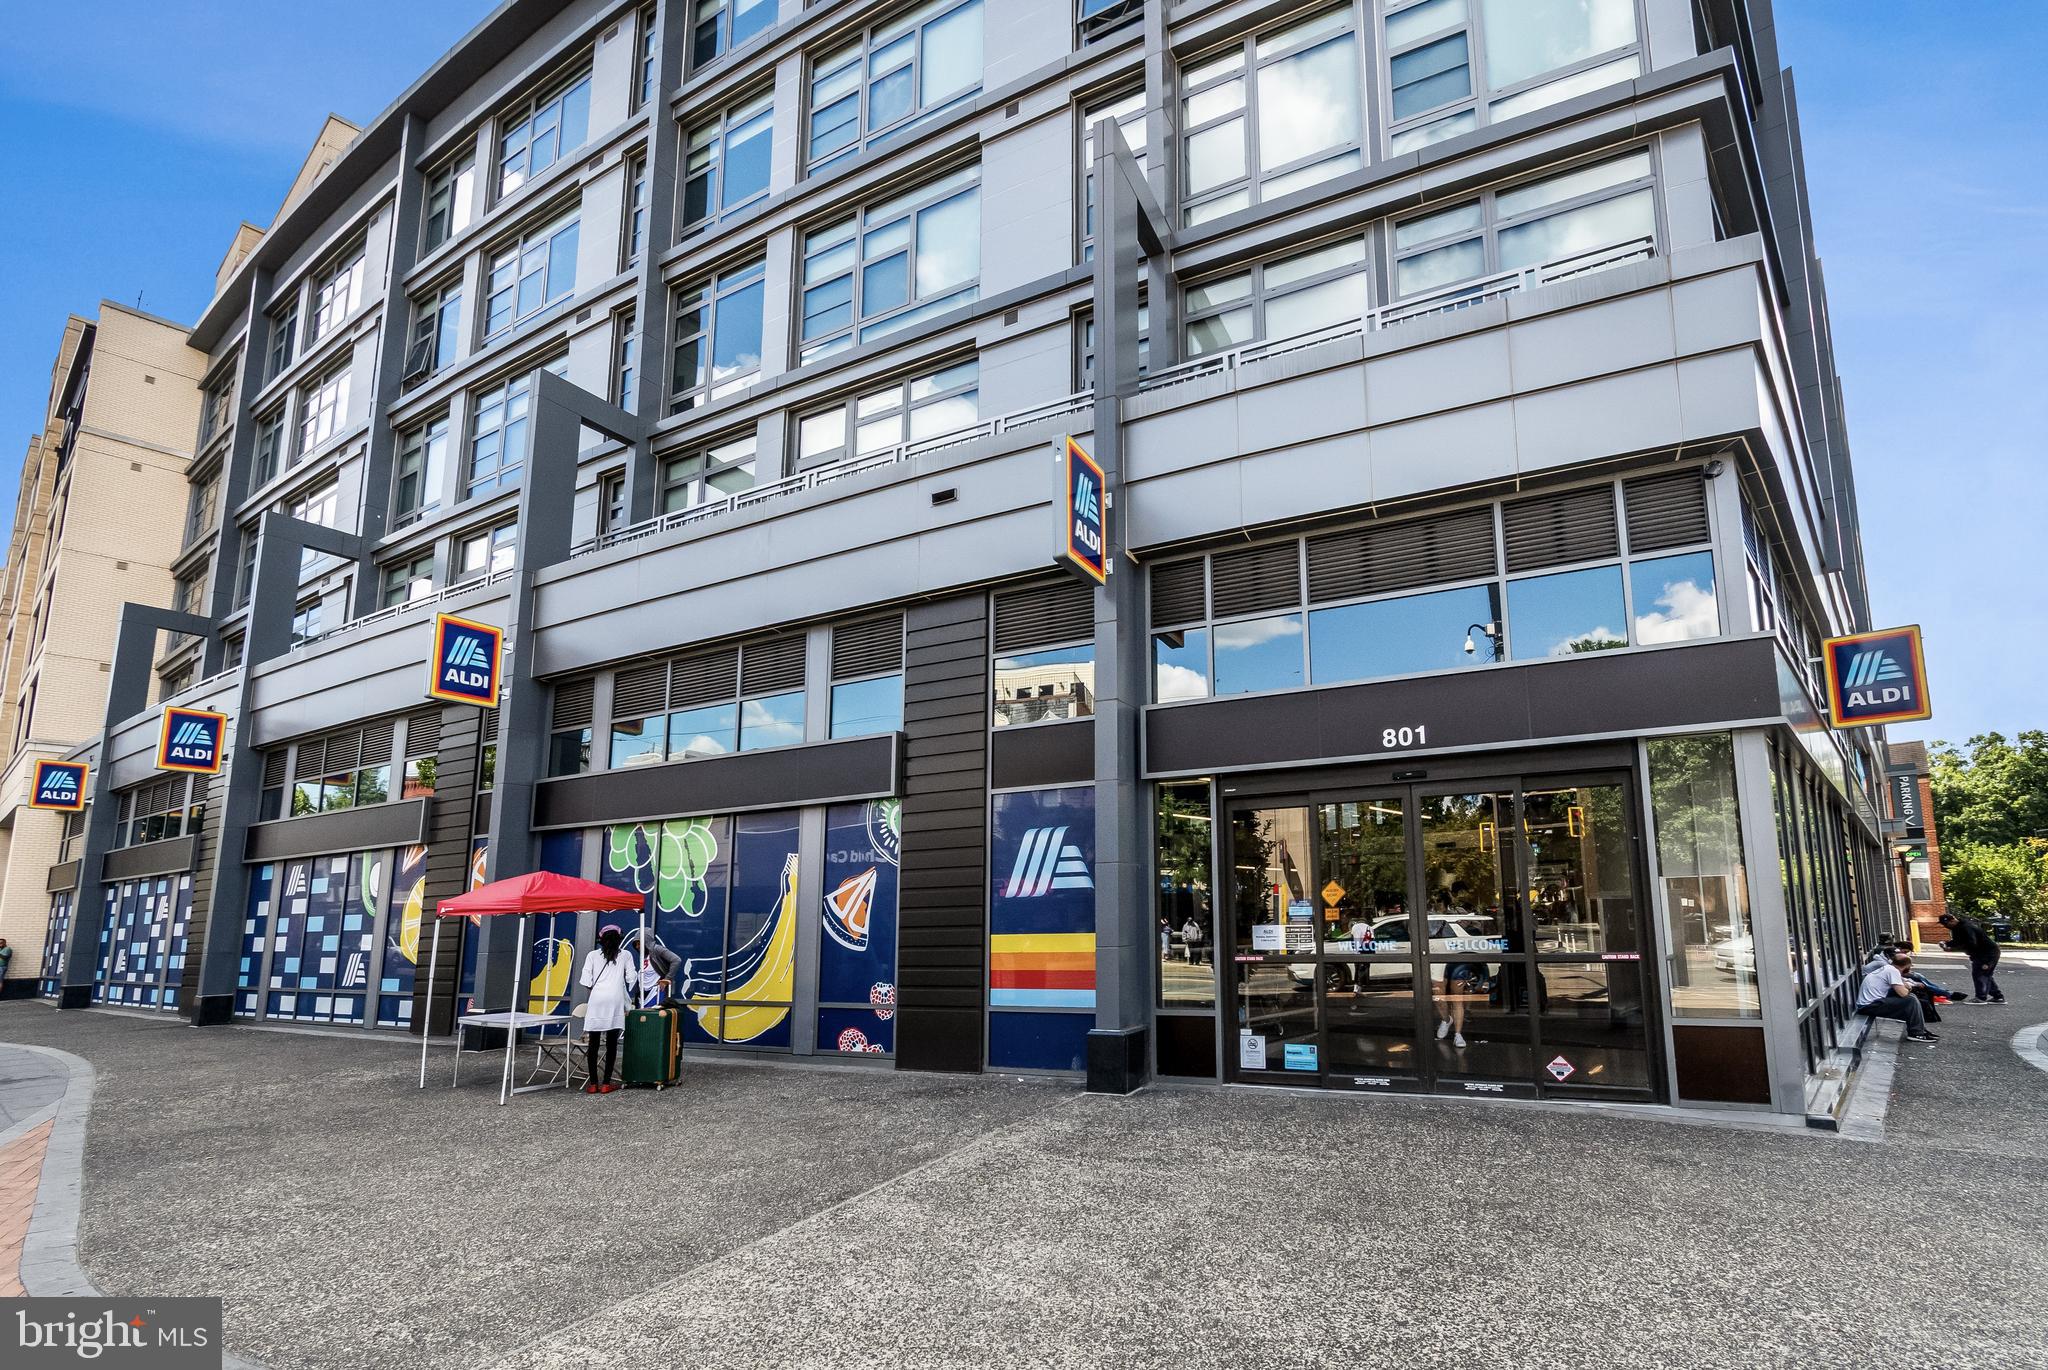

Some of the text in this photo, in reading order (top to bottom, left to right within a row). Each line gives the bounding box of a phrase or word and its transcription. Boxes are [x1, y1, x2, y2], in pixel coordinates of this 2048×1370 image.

[1074, 519, 1101, 555] ALDI
[444, 668, 489, 689] ALDI
[1847, 685, 1911, 708] ALDI
[1382, 725, 1426, 748] 801
[170, 746, 213, 761] ALDI
[40, 790, 77, 801] ALDI
[1899, 776, 1914, 815] PARKING
[1338, 940, 1396, 951] WELCOME
[1445, 939, 1509, 950] WELCOME
